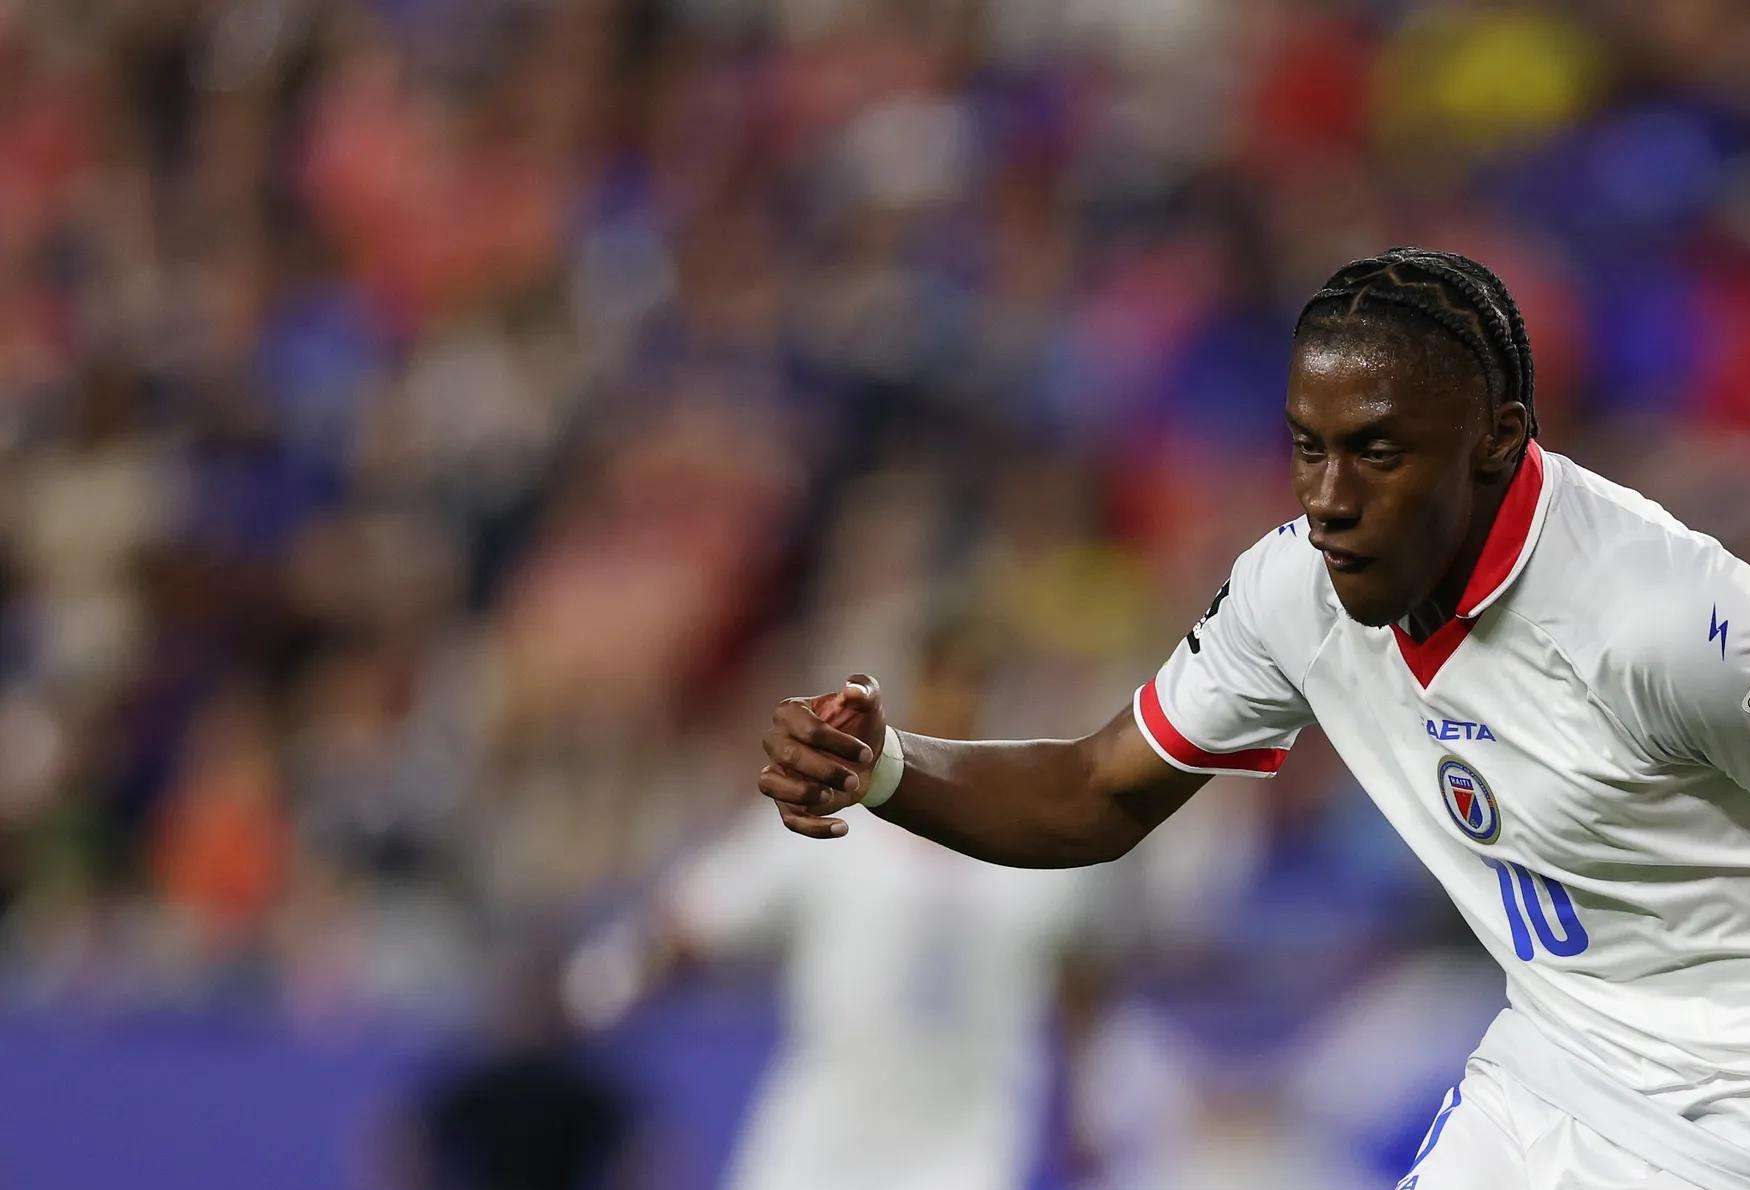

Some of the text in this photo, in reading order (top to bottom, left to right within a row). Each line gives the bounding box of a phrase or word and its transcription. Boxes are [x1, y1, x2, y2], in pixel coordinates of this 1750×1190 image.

[1418, 716, 1497, 742] AETA
[1450, 776, 1473, 788] HAITI
[1480, 856, 1590, 962] 10
